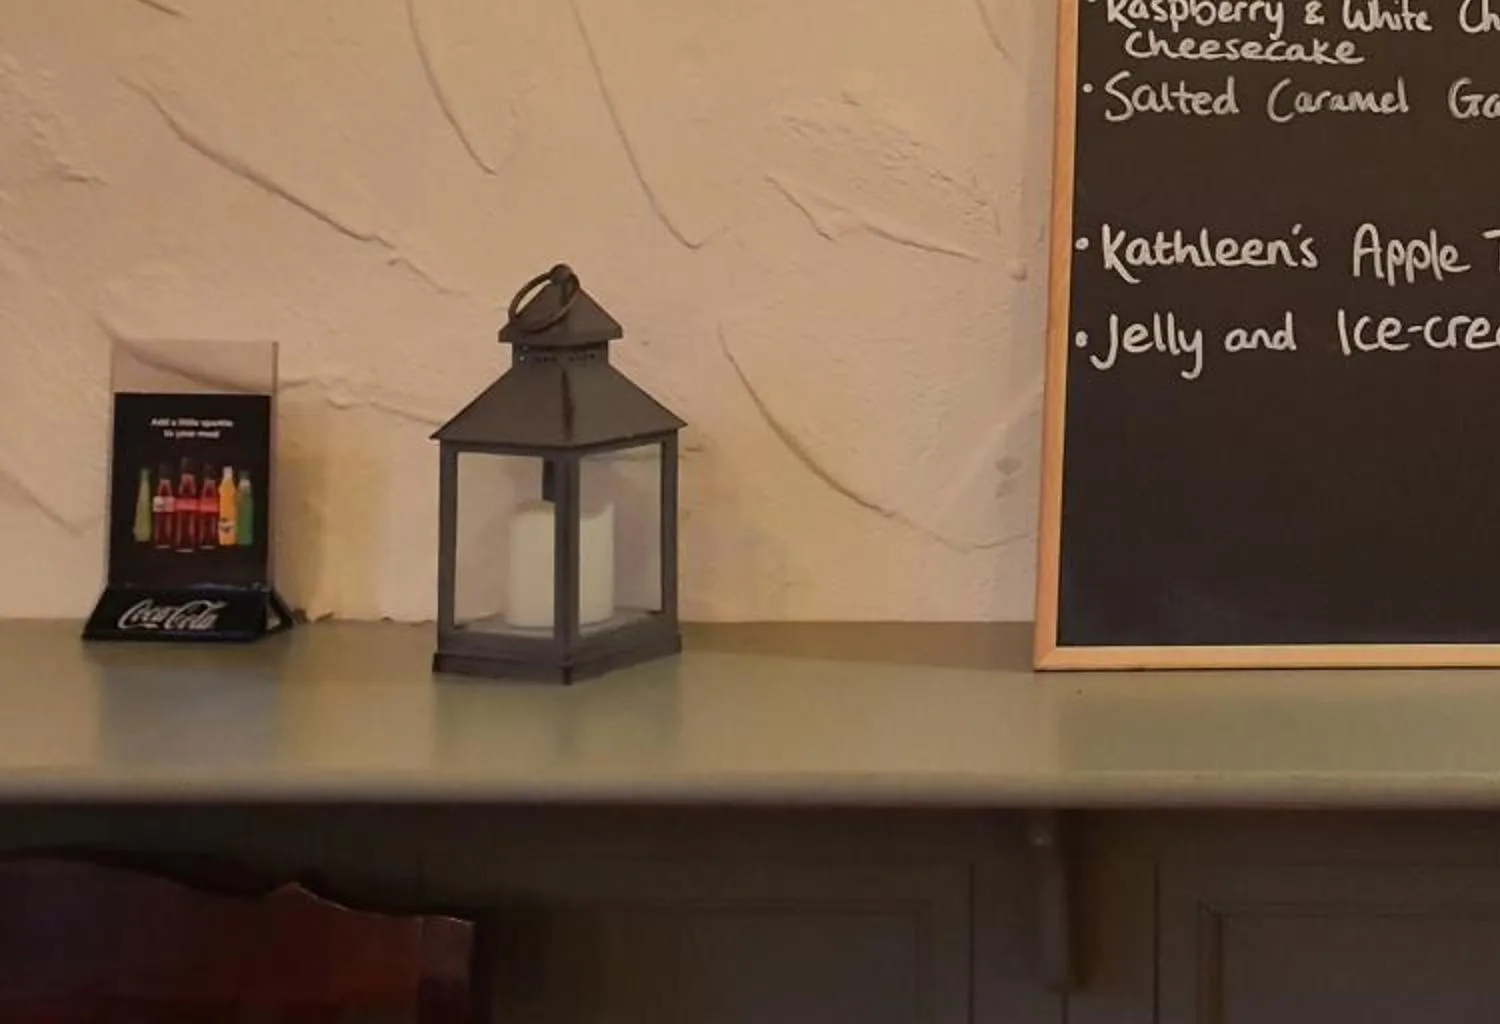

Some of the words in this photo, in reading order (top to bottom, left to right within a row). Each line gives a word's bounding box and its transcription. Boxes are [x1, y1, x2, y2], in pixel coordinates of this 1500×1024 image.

[1304, 0, 1326, 25] &
[1104, 70, 1240, 122] Salted
[1267, 77, 1410, 123] Caramel
[1101, 223, 1318, 284] Kathleen's
[1353, 222, 1471, 287] Apple
[1089, 311, 1204, 378] Jelly
[1224, 311, 1297, 354] and
